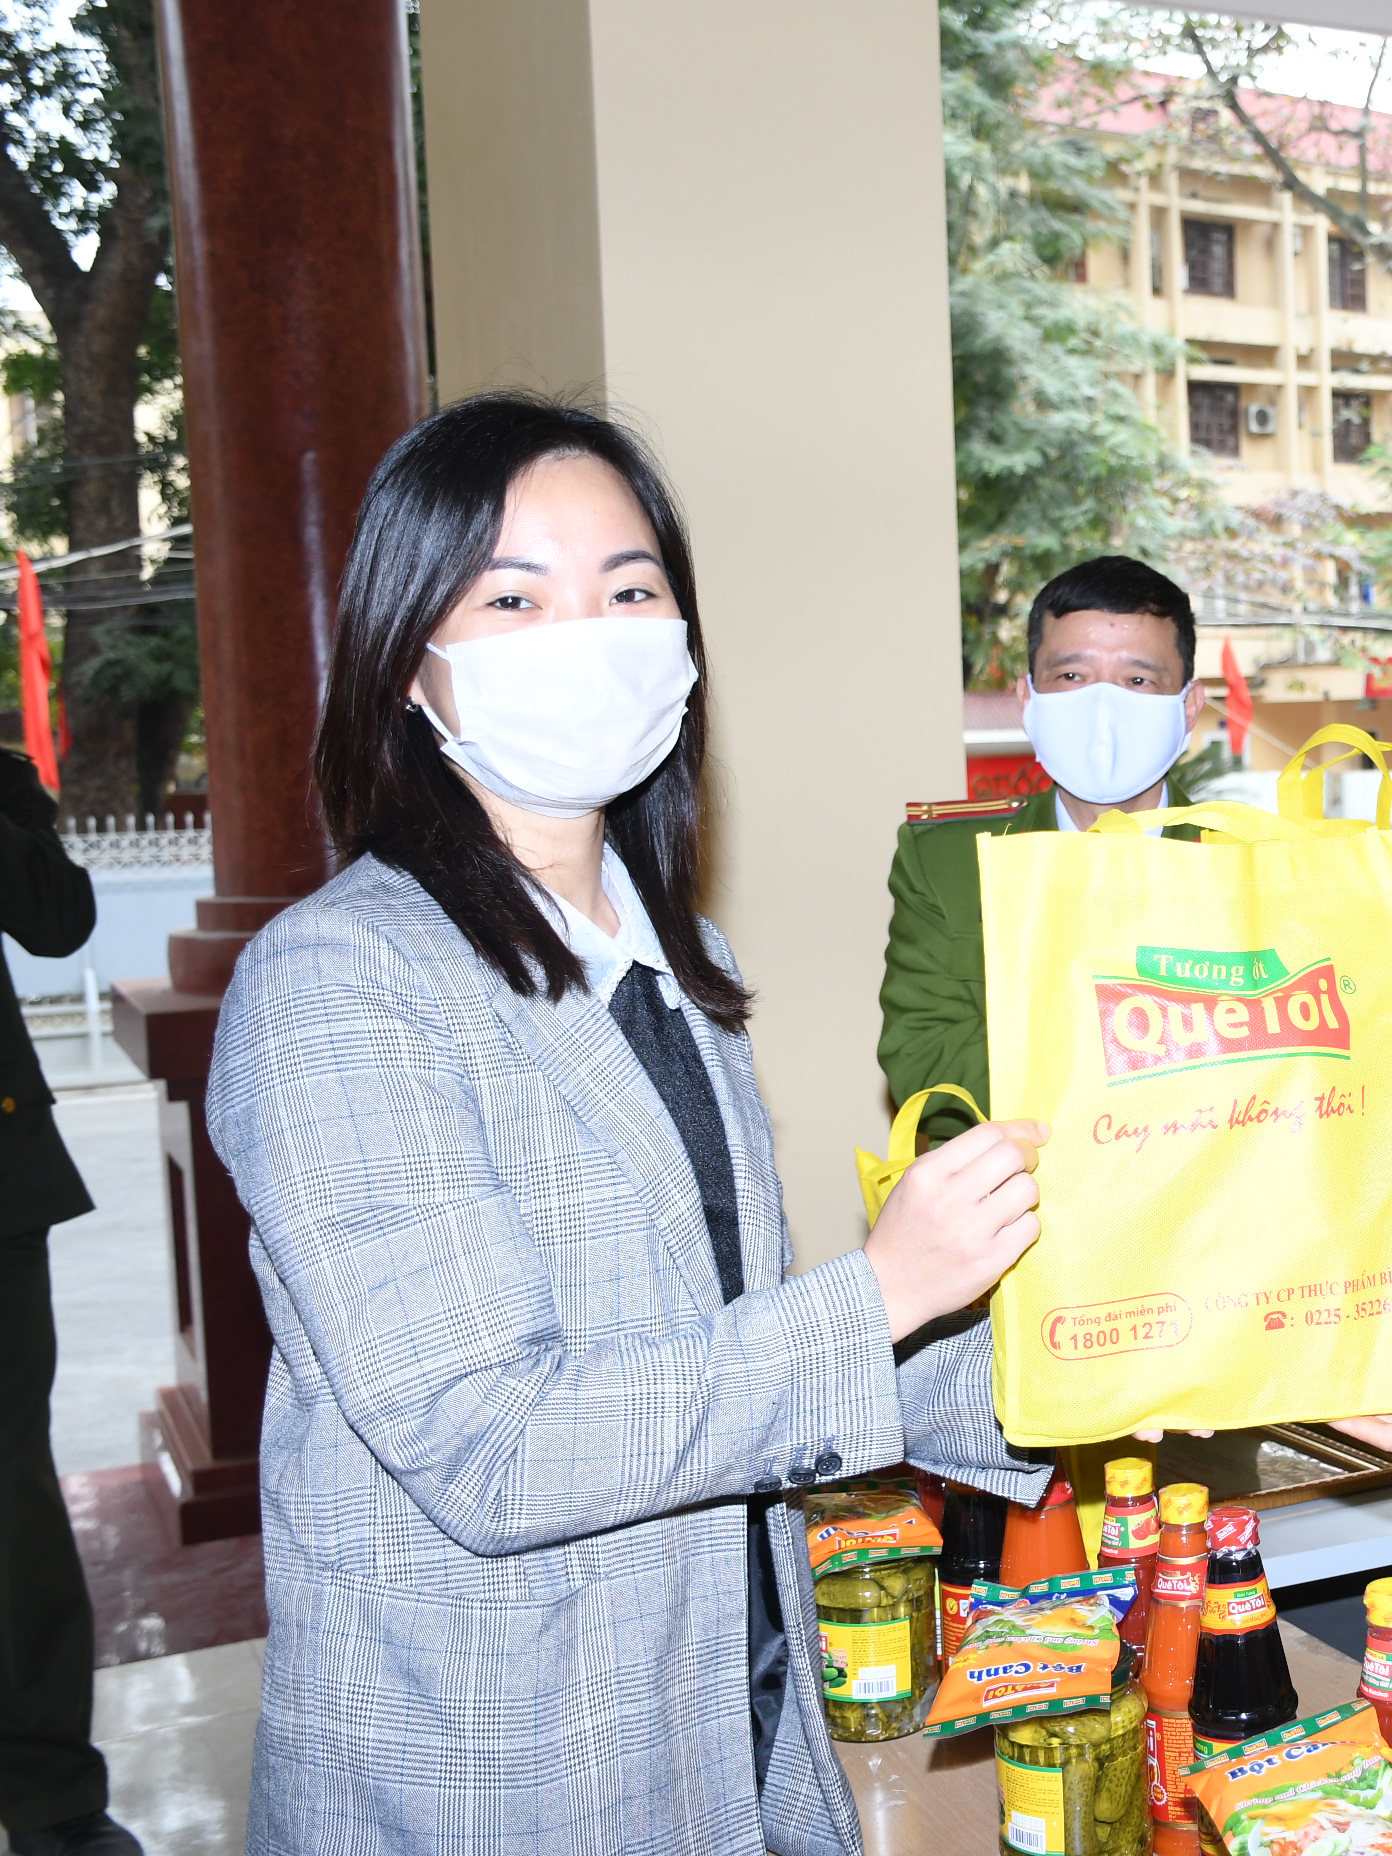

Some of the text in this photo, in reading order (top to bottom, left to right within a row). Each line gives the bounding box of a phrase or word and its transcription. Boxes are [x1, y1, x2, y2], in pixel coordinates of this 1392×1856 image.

[1153, 954, 1245, 986] Tương
[1093, 1113, 1150, 1153] Cay
[1228, 1094, 1306, 1134] không
[1204, 1292, 1249, 1311] CÔNG
[1253, 1290, 1273, 1306] TY
[1276, 1287, 1295, 1303] CP
[1298, 1280, 1340, 1300] THỰC
[1071, 1301, 1177, 1327] Tổng đài miễn phí
[1304, 1308, 1342, 1326] 0225
[1069, 1318, 1179, 1350] 1800 1271
[1229, 1596, 1264, 1613] QuêTôi
[967, 1661, 1034, 1682] Canh
[1228, 1755, 1279, 1780] Bột
